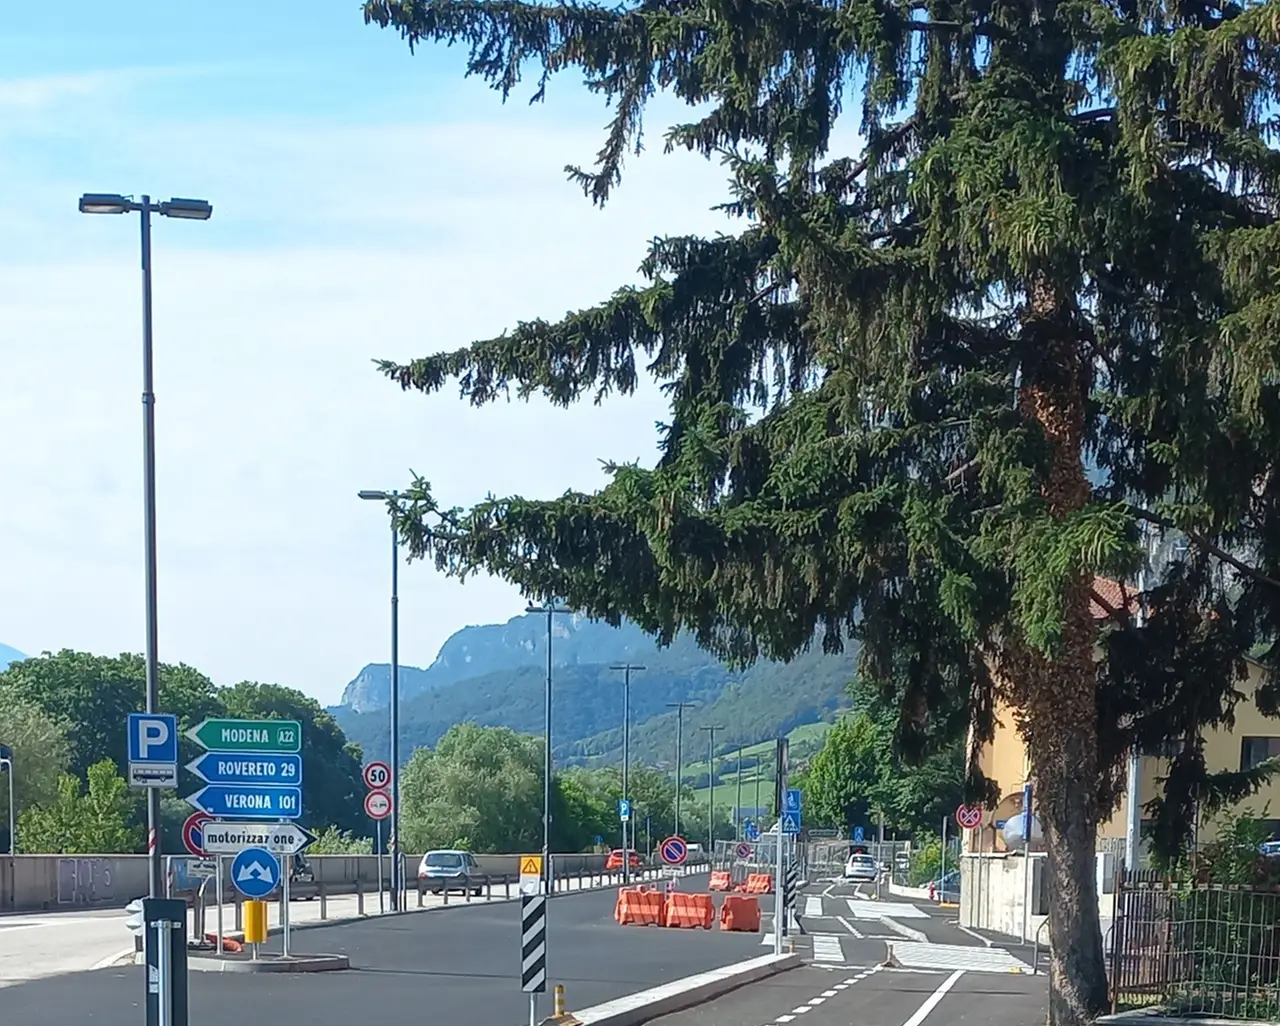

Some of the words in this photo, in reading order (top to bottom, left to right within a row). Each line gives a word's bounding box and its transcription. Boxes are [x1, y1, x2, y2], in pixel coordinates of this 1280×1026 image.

[138, 720, 169, 758] P
[222, 729, 269, 743] MODENA
[279, 731, 295, 743] A22
[219, 761, 276, 776] ROVERETO
[281, 763, 295, 777] 29
[371, 769, 385, 782] 50
[225, 794, 271, 809] VERONA
[279, 795, 296, 809] 101
